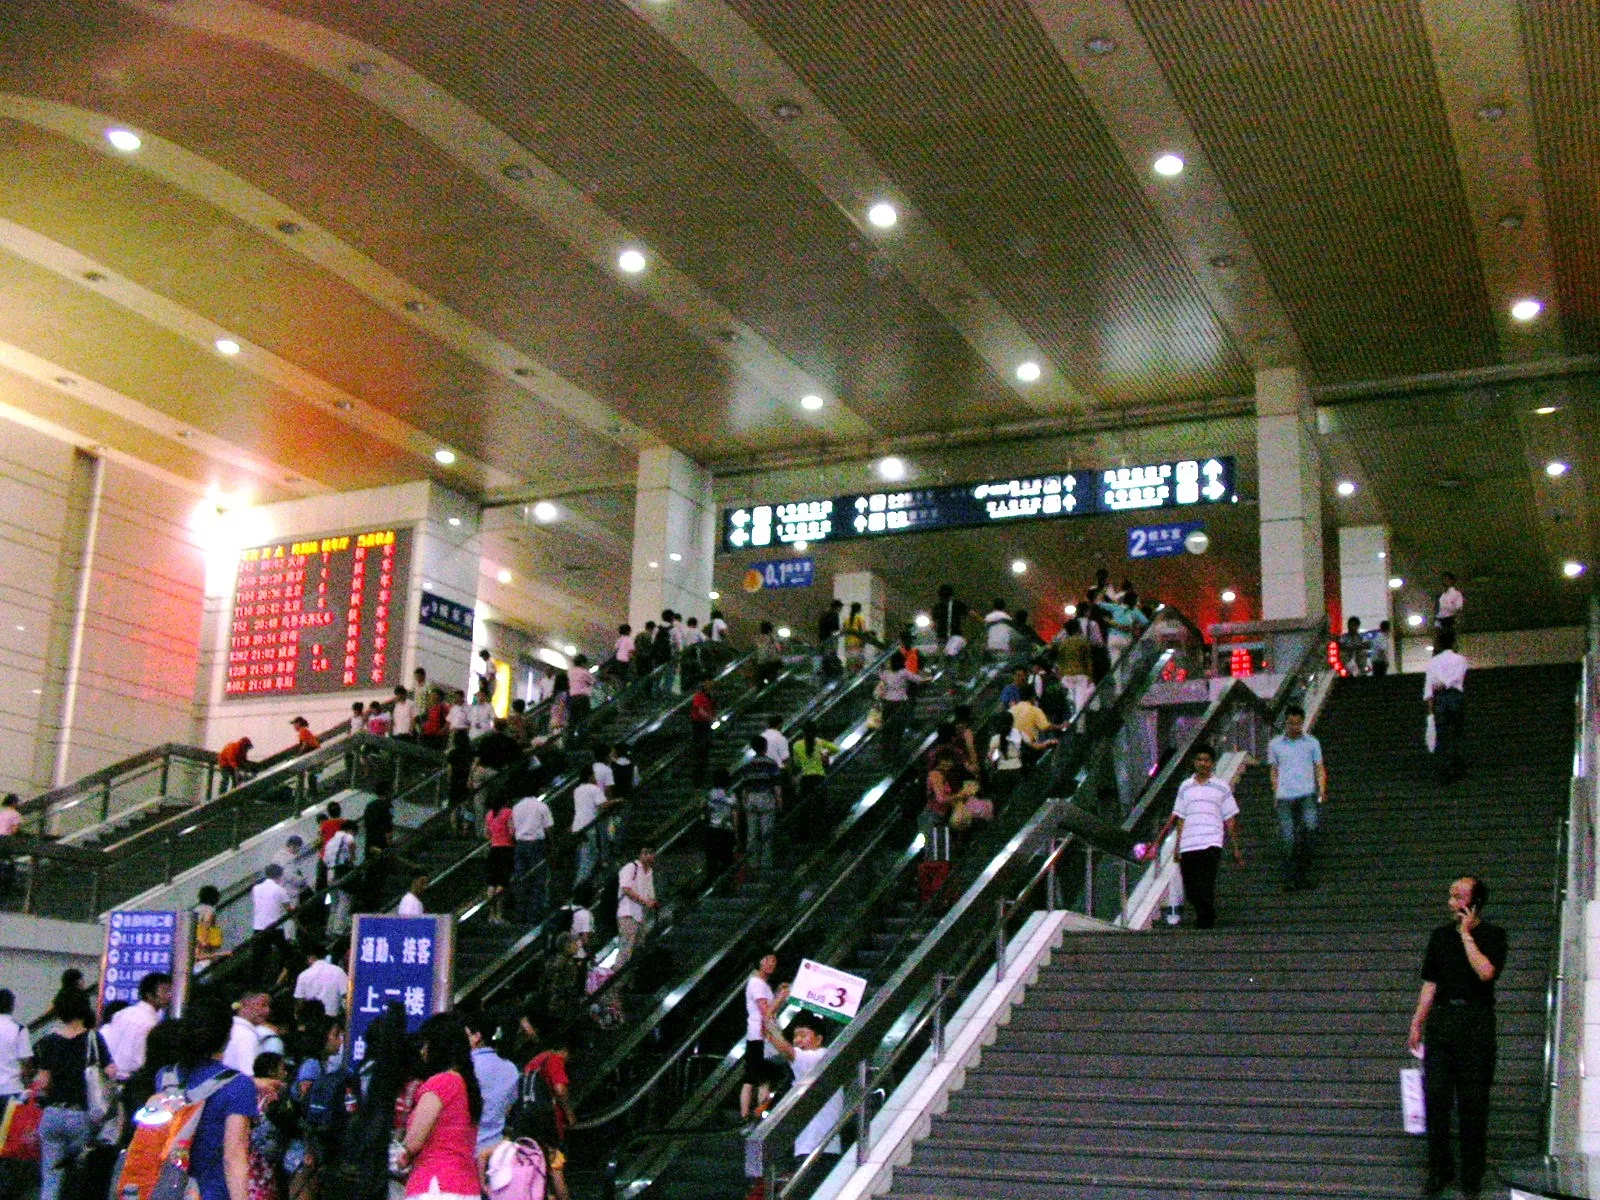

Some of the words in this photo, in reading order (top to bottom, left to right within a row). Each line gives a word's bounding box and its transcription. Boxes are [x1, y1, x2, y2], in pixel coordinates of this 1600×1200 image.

[1131, 529, 1148, 557] 2
[359, 985, 426, 1016] 上二楼
[806, 990, 826, 1003] BUS
[828, 987, 848, 1008] 3
